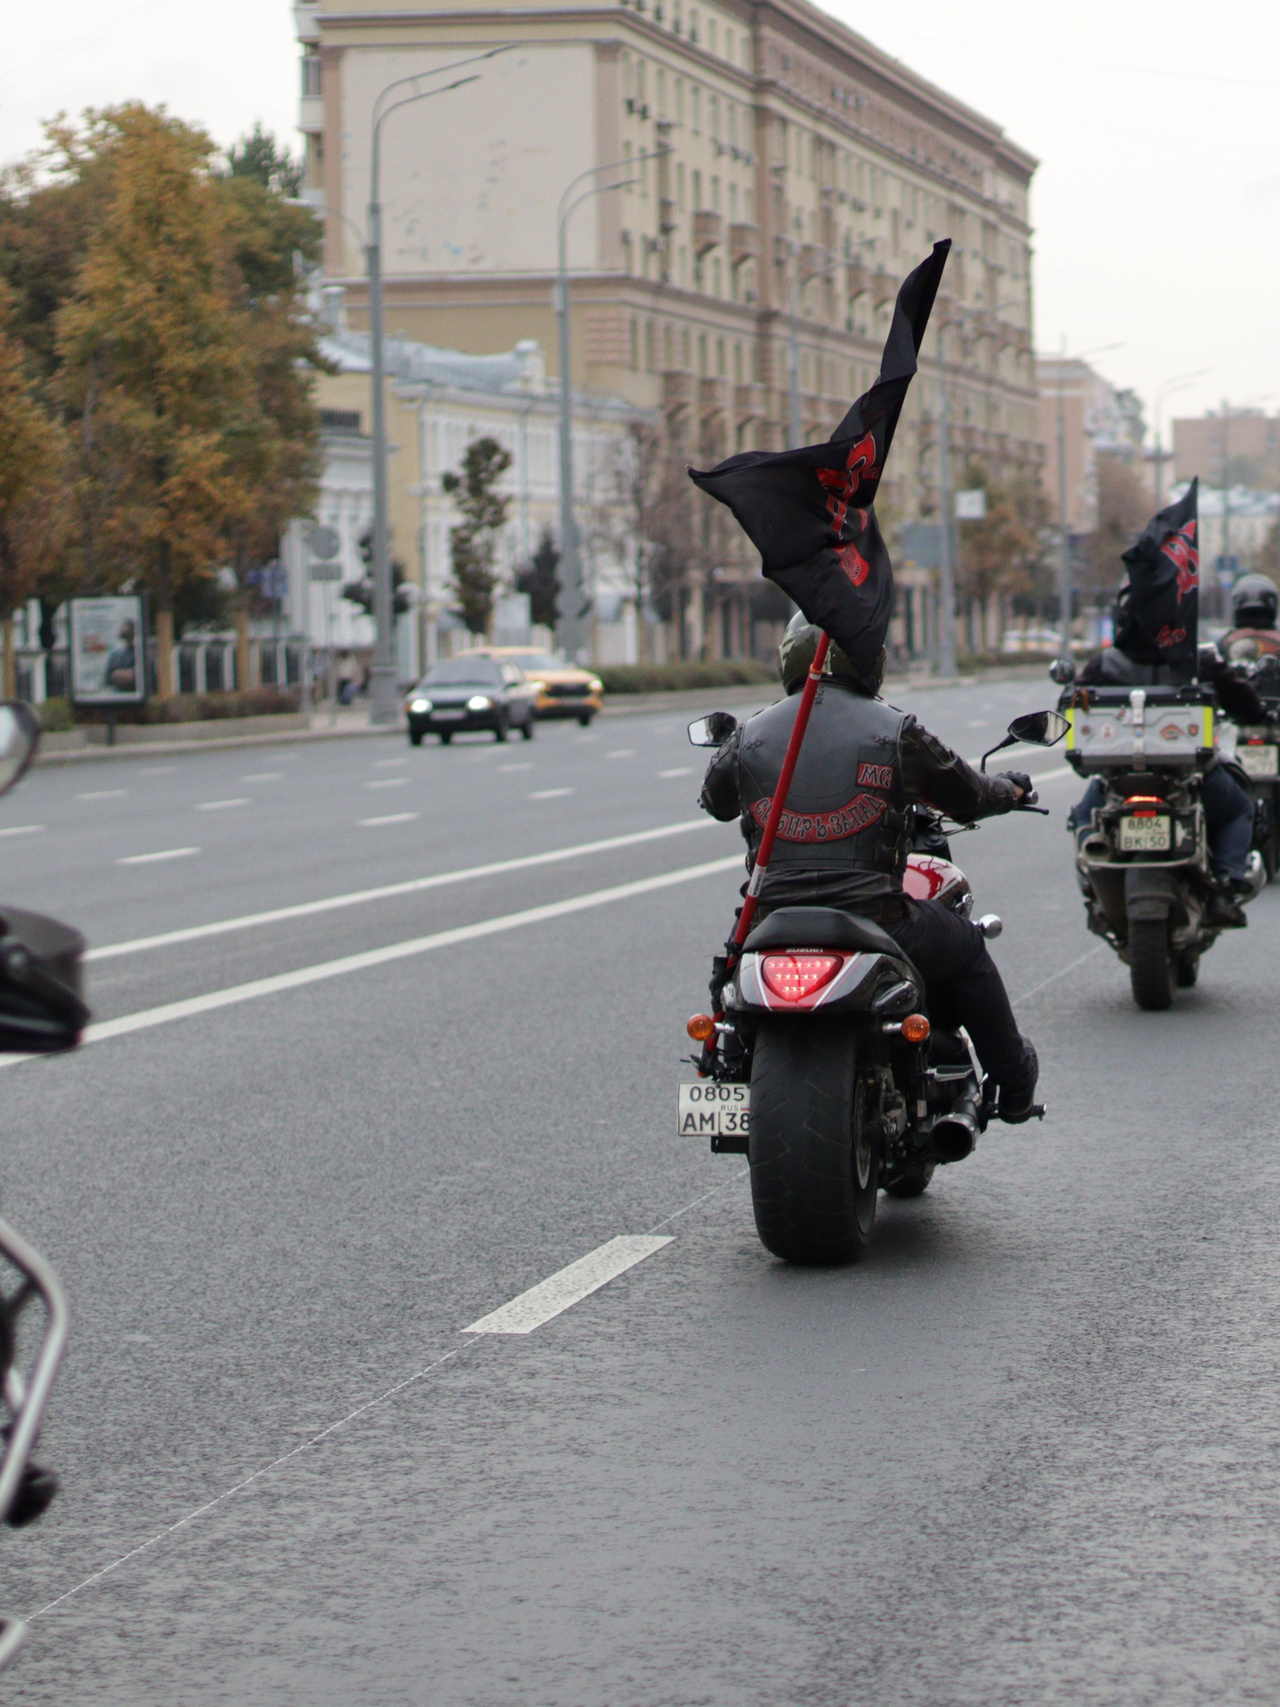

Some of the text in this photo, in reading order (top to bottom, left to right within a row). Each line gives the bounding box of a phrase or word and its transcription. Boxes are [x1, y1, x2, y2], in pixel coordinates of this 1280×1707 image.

[858, 764, 892, 788] MC
[829, 793, 887, 835] ЗАПАД
[1150, 836, 1166, 848] 50
[689, 1086, 745, 1102] 0805
[682, 1112, 750, 1132] AM 38
